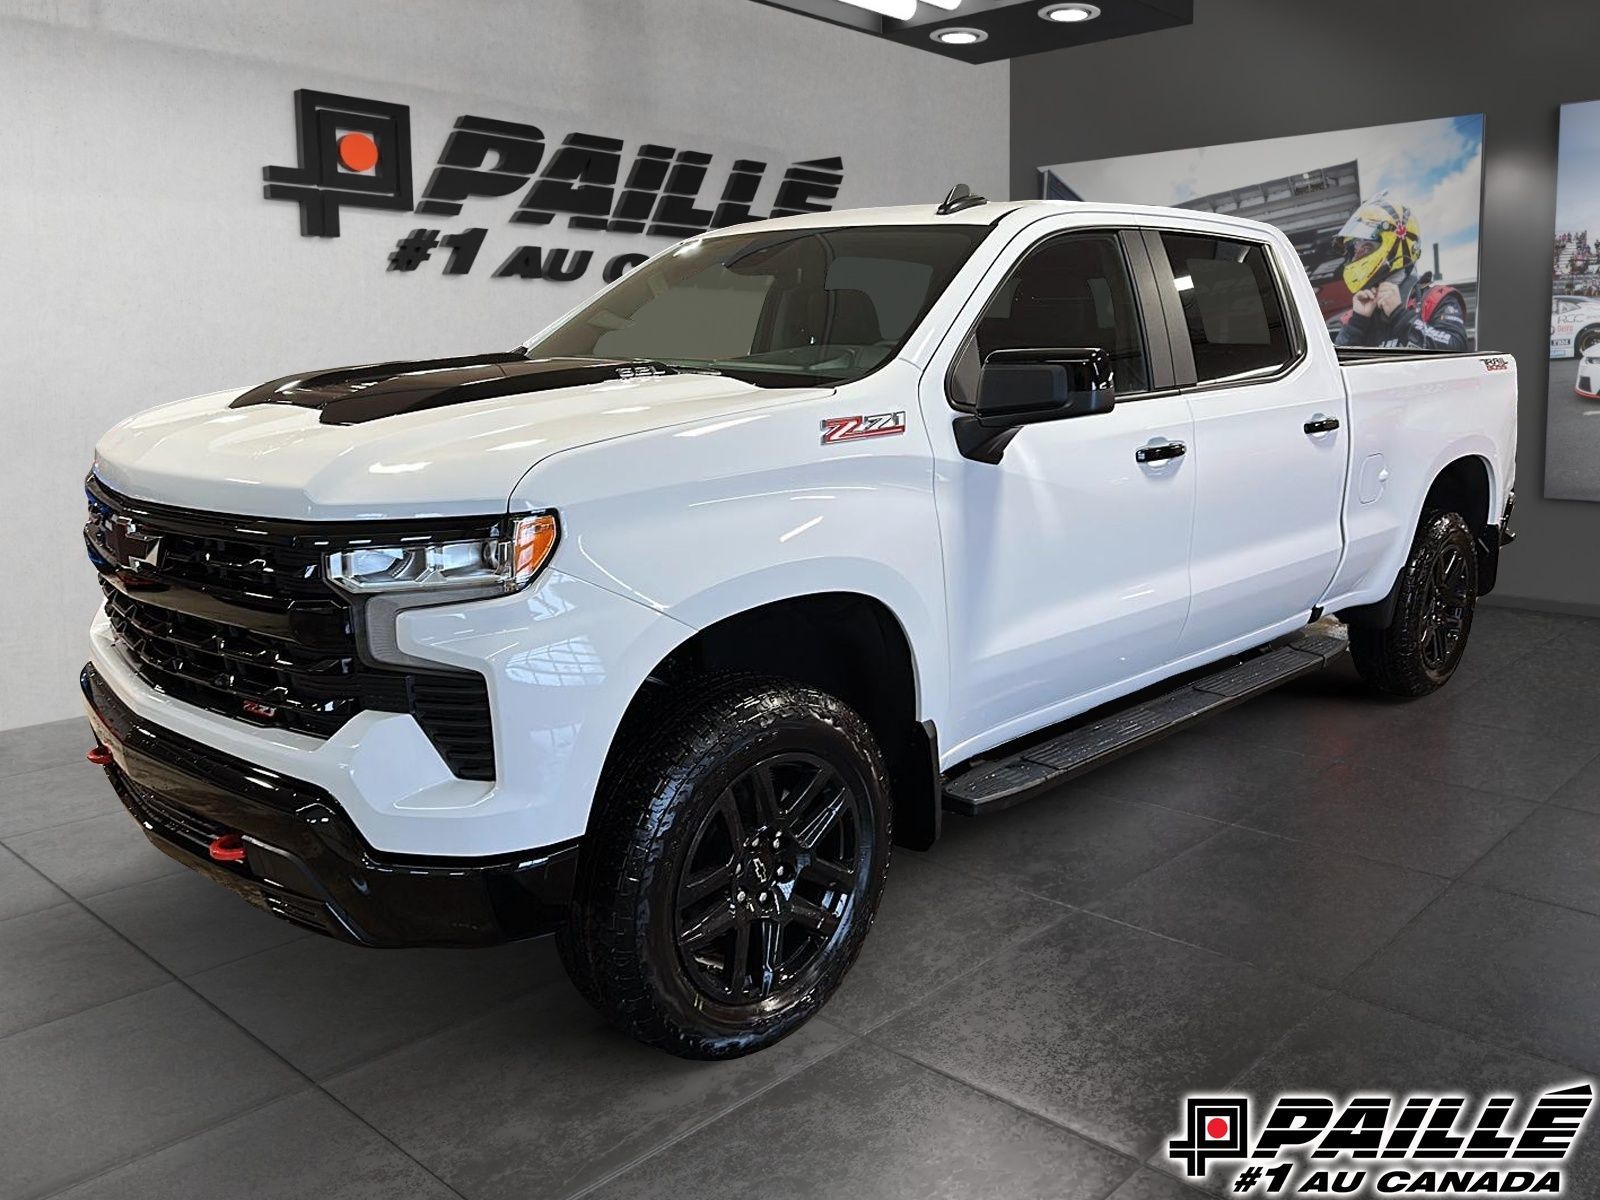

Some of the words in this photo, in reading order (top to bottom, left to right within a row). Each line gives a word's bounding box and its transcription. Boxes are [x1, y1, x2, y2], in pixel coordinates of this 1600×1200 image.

[414, 114, 844, 237] PAILLÉ
[386, 227, 488, 275] #1
[491, 246, 594, 282] AU
[820, 411, 906, 445] Z71
